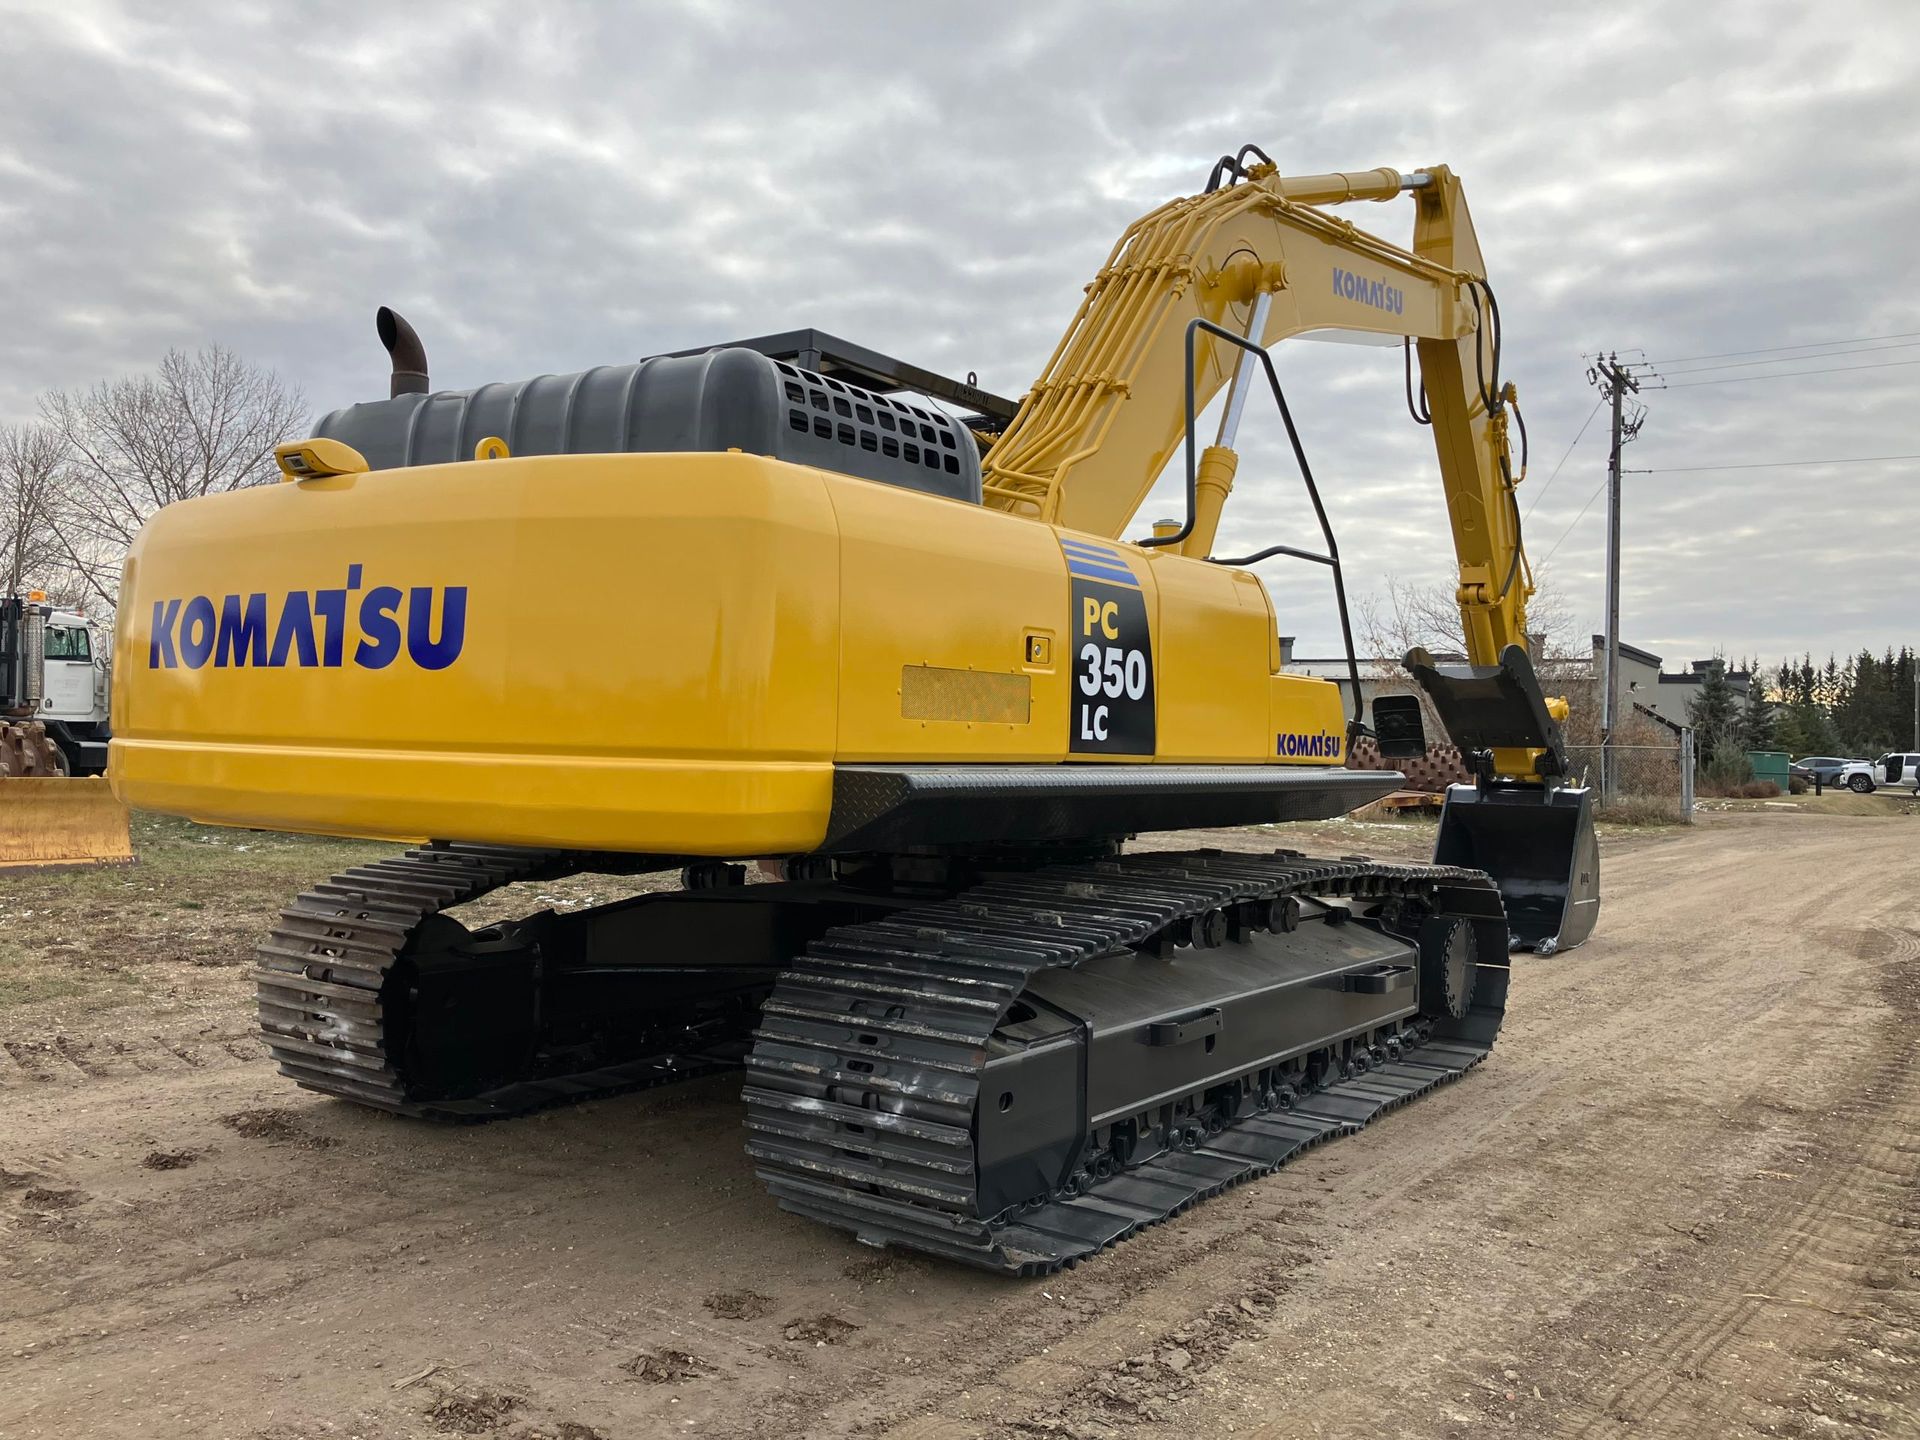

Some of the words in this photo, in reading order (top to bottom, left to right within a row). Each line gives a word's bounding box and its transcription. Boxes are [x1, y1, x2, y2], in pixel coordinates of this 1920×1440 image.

[1333, 267, 1403, 315] KOMATSU
[149, 564, 467, 670] KOMATSU
[1083, 597, 1119, 640] PC
[1079, 643, 1147, 700] 350
[1081, 704, 1109, 741] LC
[1277, 729, 1340, 757] KOMATSU
